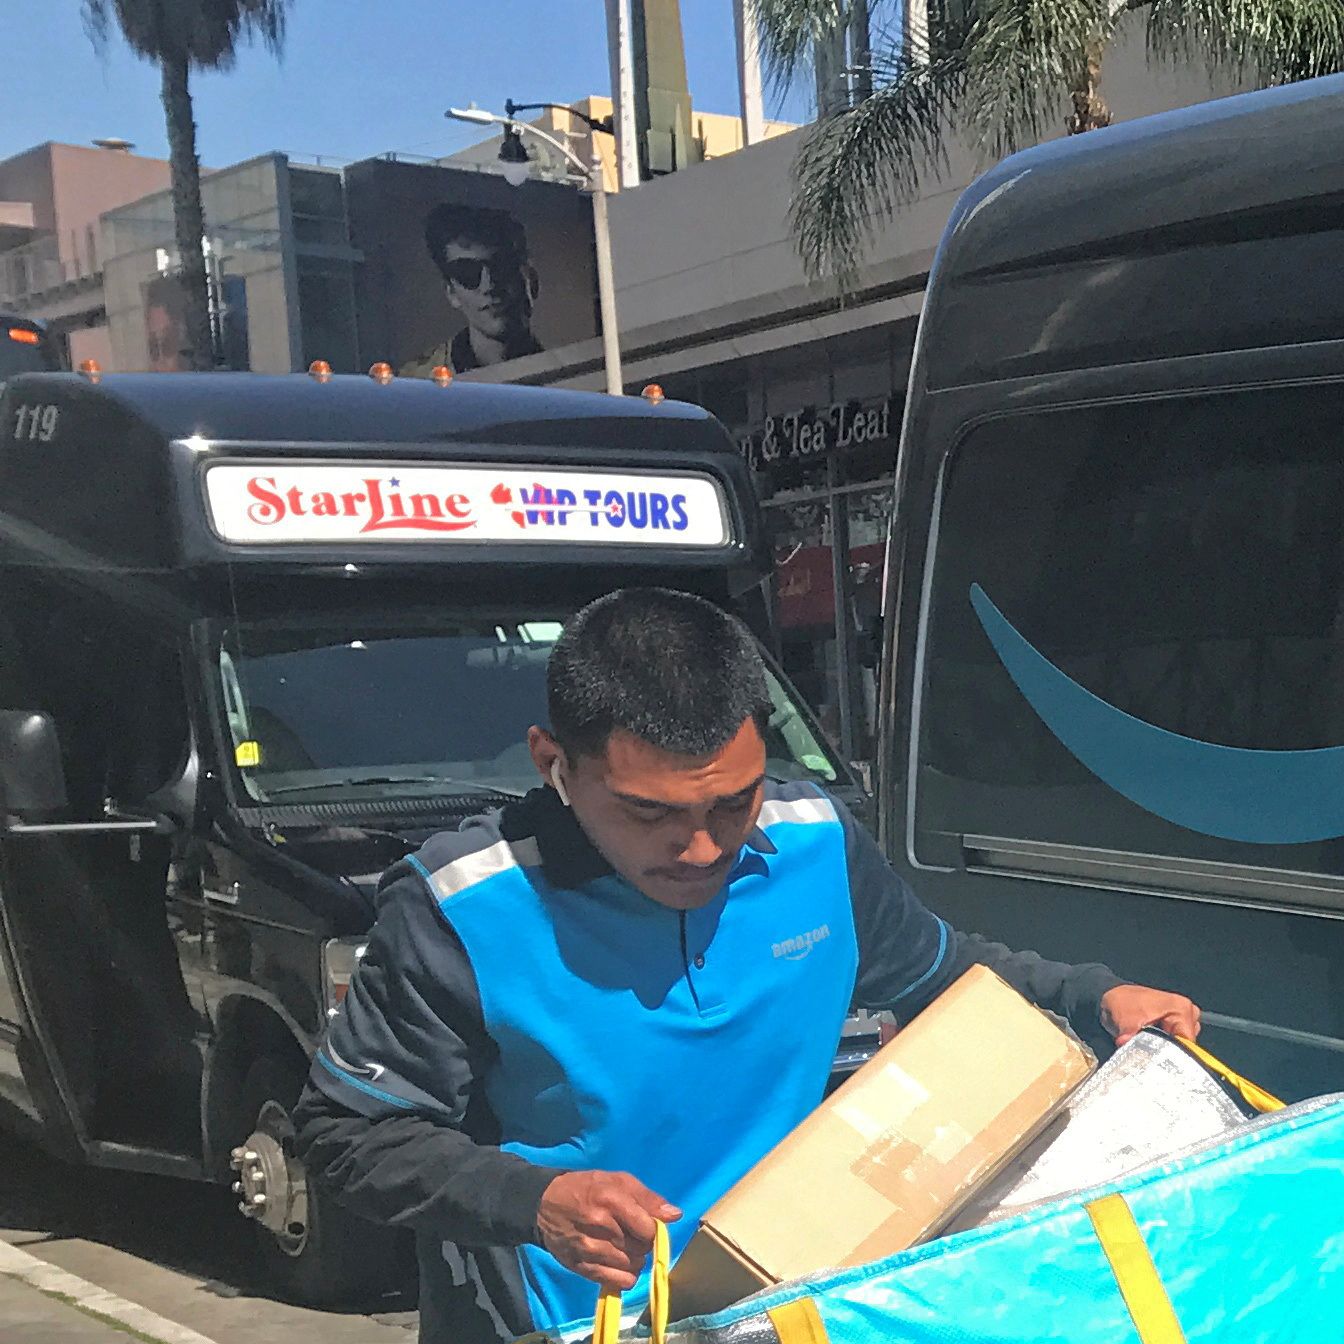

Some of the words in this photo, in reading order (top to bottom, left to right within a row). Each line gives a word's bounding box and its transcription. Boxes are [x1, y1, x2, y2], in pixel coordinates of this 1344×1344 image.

[14, 404, 59, 441] 119
[762, 415, 781, 462] &
[783, 408, 826, 457] Tea
[519, 487, 577, 526] VIP
[583, 489, 688, 531] TOURS
